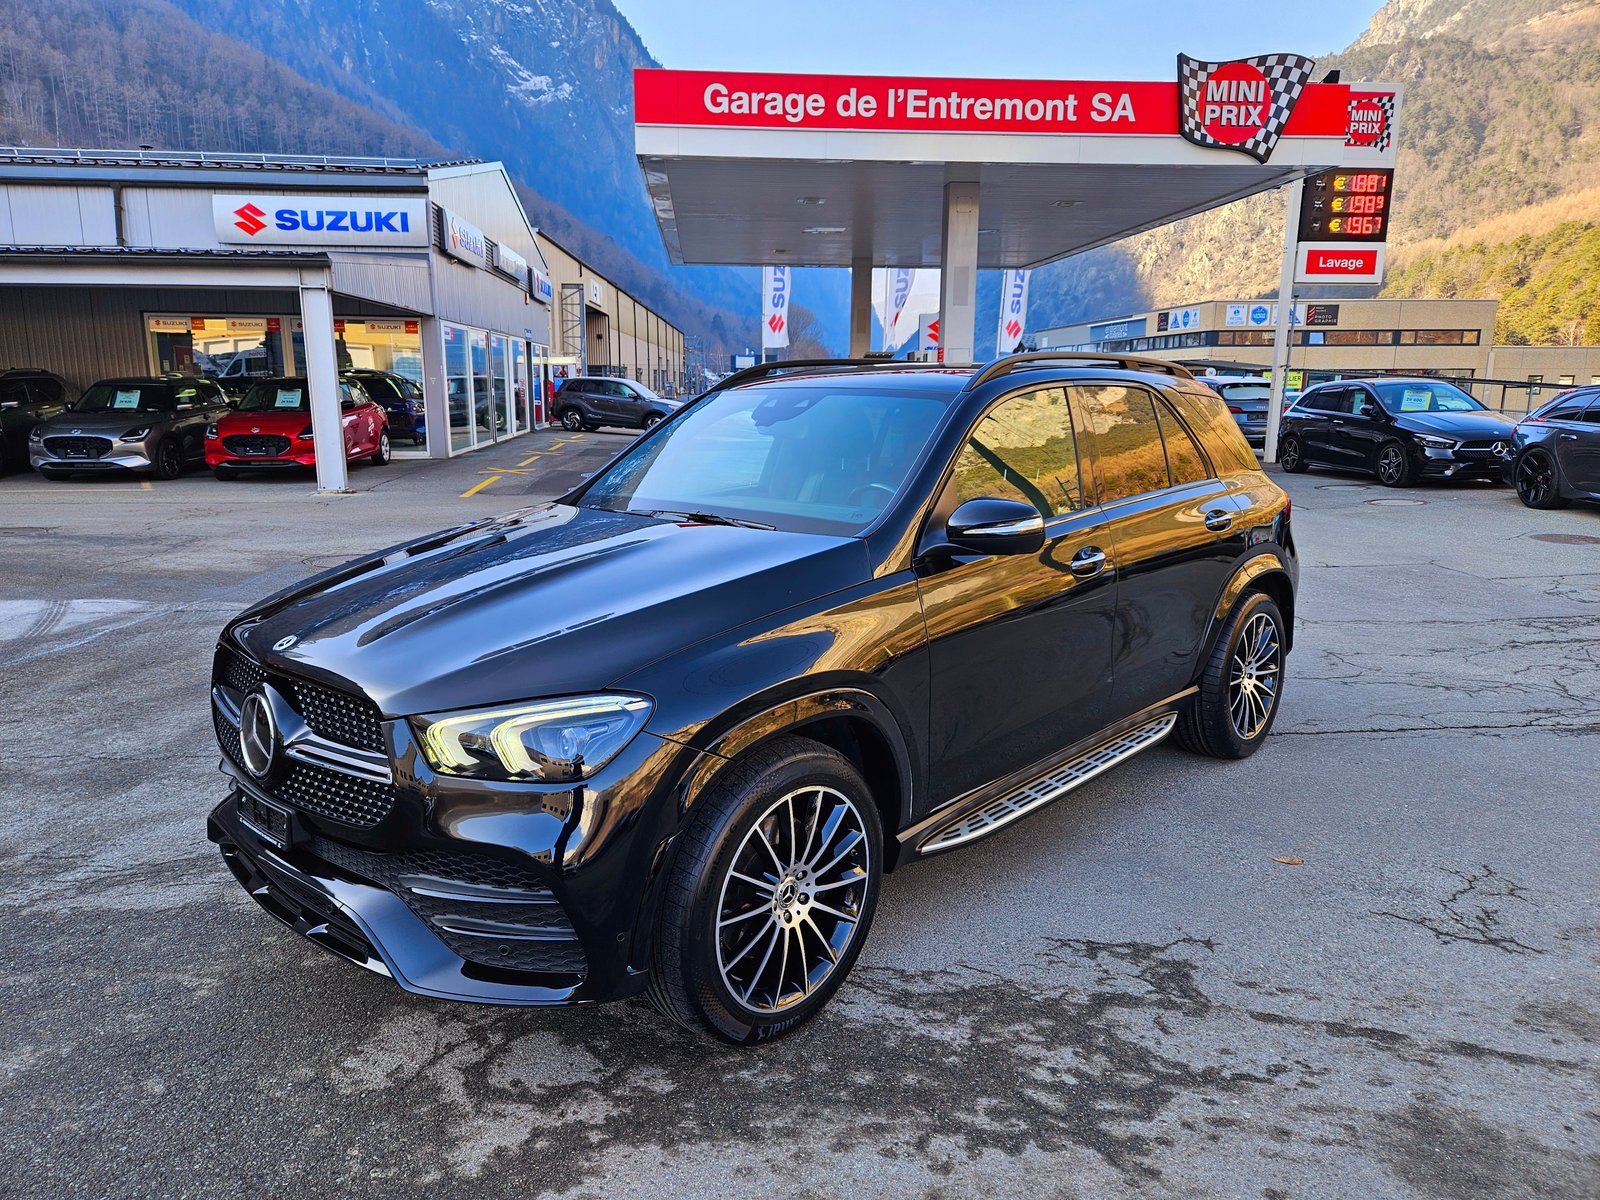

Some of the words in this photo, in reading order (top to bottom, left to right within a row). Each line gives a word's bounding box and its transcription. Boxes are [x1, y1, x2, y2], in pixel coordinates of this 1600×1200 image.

[703, 83, 825, 123] Garage
[836, 88, 877, 118] de
[888, 89, 1078, 121] l'Entremont
[1090, 93, 1136, 122] SA
[1206, 80, 1265, 103] MINI
[1204, 105, 1264, 127] PRIX
[1350, 110, 1382, 122] MINI
[1349, 123, 1380, 135] PRIX
[275, 209, 410, 233] SUZUKI
[1319, 257, 1364, 271] Lavage
[772, 265, 786, 309] SUZ
[894, 267, 910, 309] SUZ
[1010, 269, 1025, 314] SUZ
